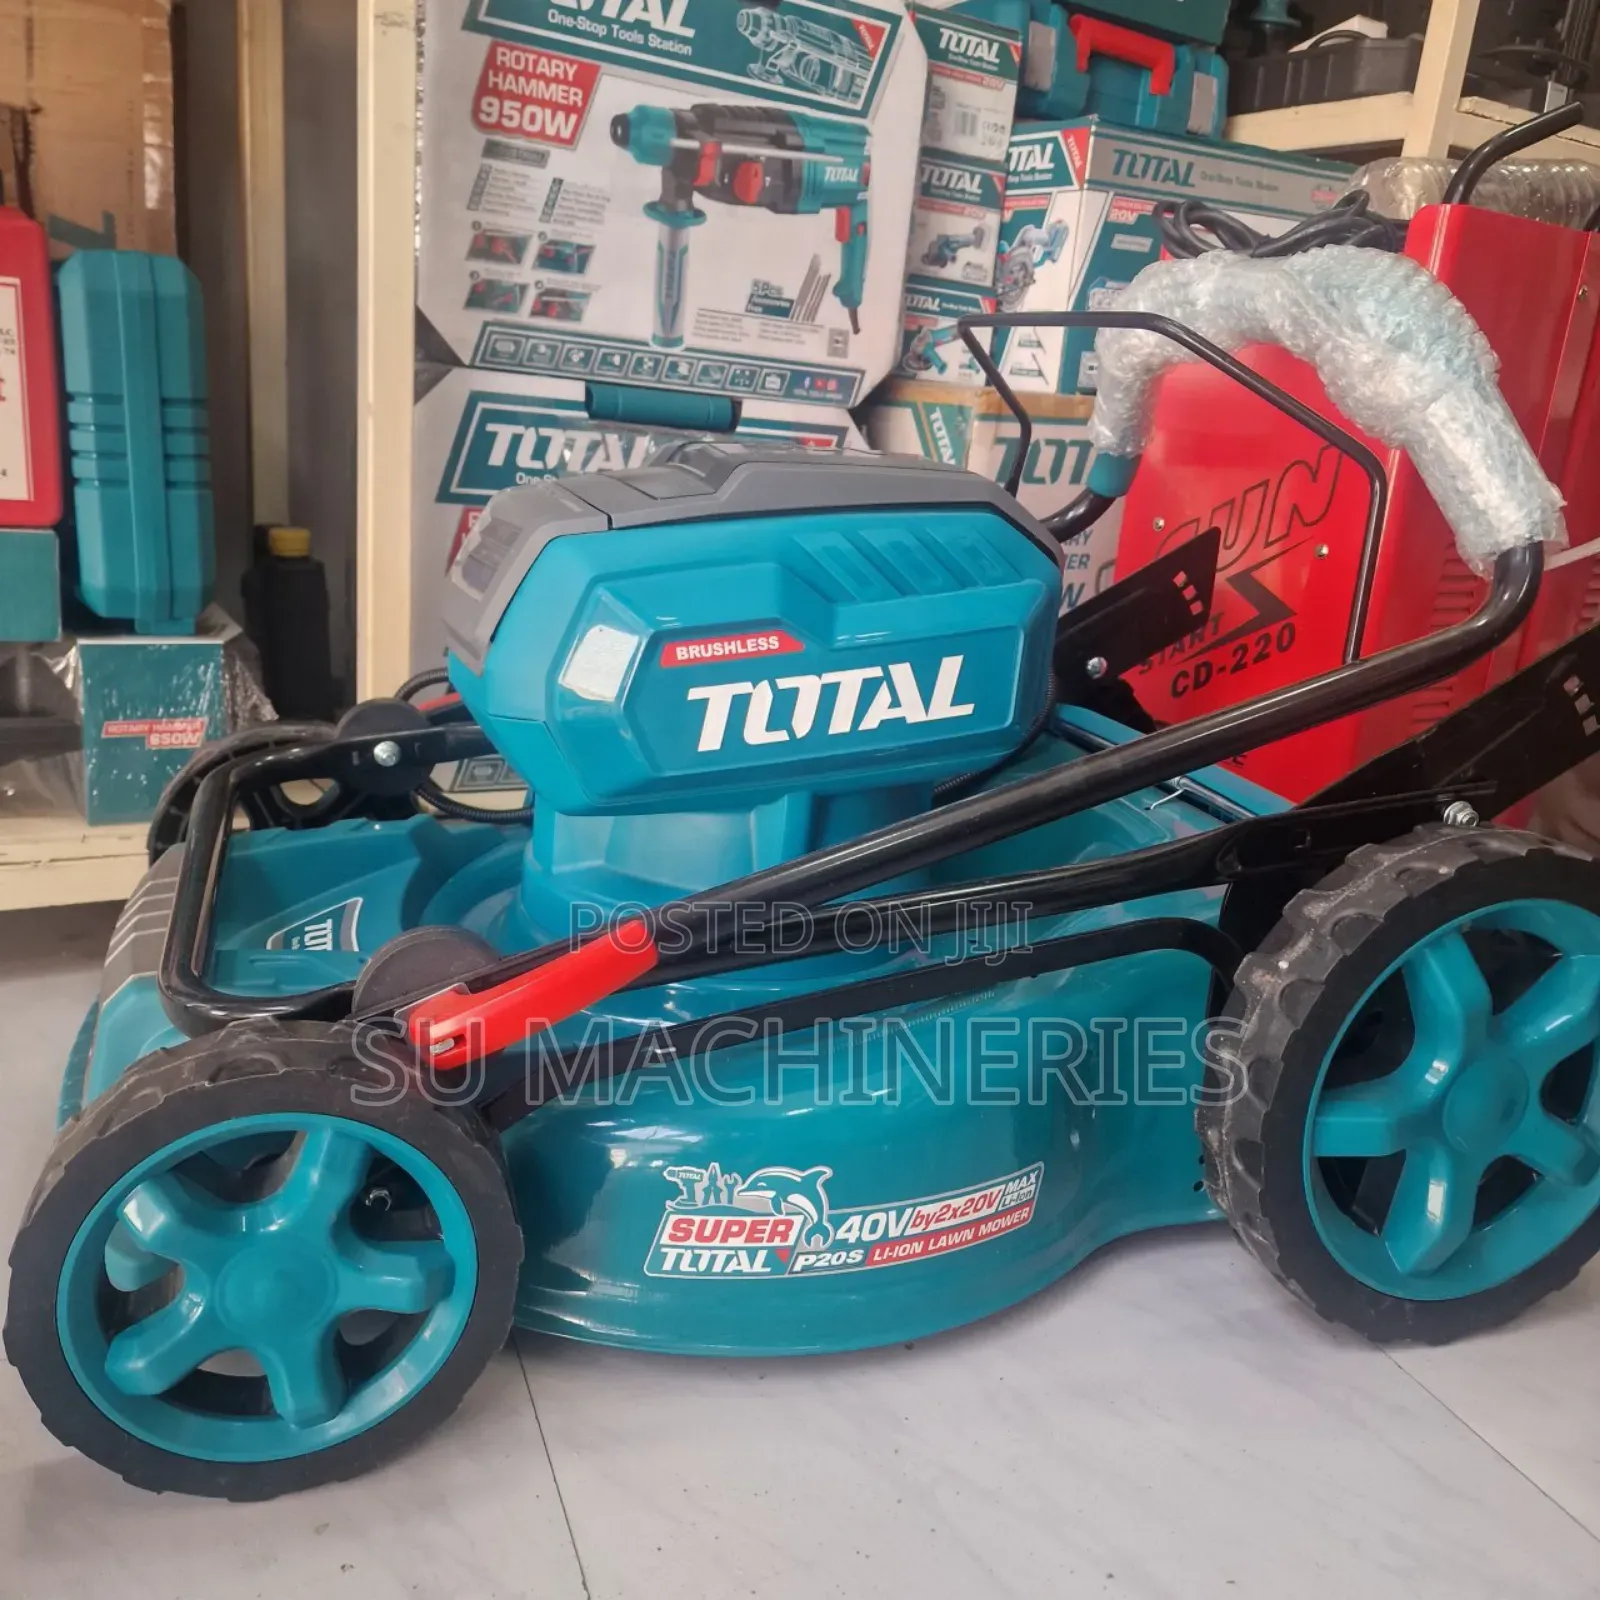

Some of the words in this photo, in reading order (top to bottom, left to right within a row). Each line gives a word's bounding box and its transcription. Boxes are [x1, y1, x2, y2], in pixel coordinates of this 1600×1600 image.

[547, 8, 607, 37] One-Stop
[611, 23, 645, 45] Tools
[647, 33, 693, 57] Station
[938, 27, 1001, 64] TOTAL
[495, 46, 579, 83] ROTARY
[486, 69, 583, 108] HAMMER
[478, 95, 578, 140] 950W
[824, 166, 860, 183] TOTAL
[920, 164, 983, 195] TOTAL
[1111, 147, 1196, 188] TOTAL
[675, 634, 781, 662] BRUSHLESS
[1170, 621, 1297, 700] CD-220
[686, 654, 976, 753] TOTAL
[677, 1171, 702, 1182] TOTAL
[1003, 1170, 1039, 1196] MAX
[668, 1217, 795, 1244] SUPER
[834, 1207, 914, 1244] 40V
[873, 1239, 925, 1262] LI-ION
[927, 1230, 975, 1251] LAWN
[978, 1206, 1031, 1237] MOWER
[660, 1247, 772, 1273] TOTAL
[791, 1247, 865, 1273] P20S
